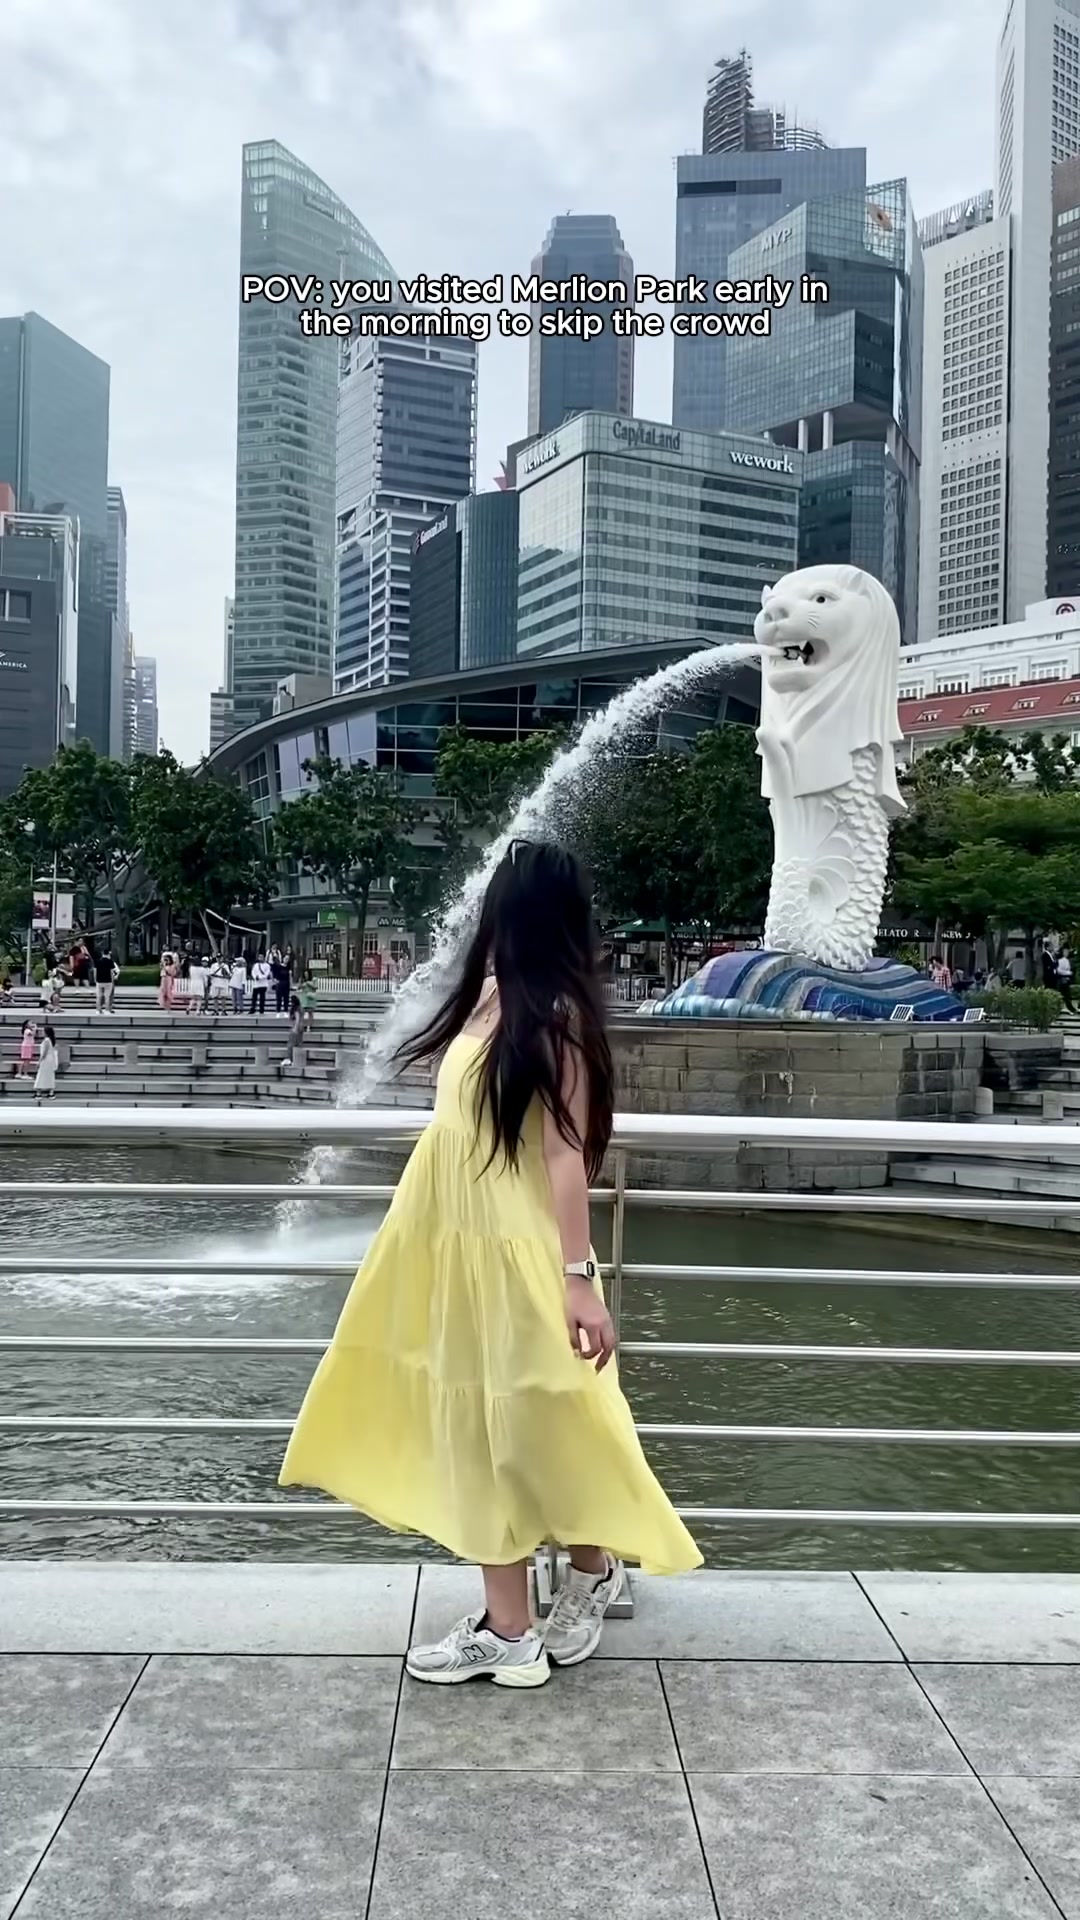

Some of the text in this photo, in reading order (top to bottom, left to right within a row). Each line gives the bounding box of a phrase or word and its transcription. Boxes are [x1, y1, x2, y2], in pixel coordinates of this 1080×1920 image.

[760, 228, 793, 252] MYP
[730, 450, 794, 473] wework
[878, 928, 908, 937] ELATO
